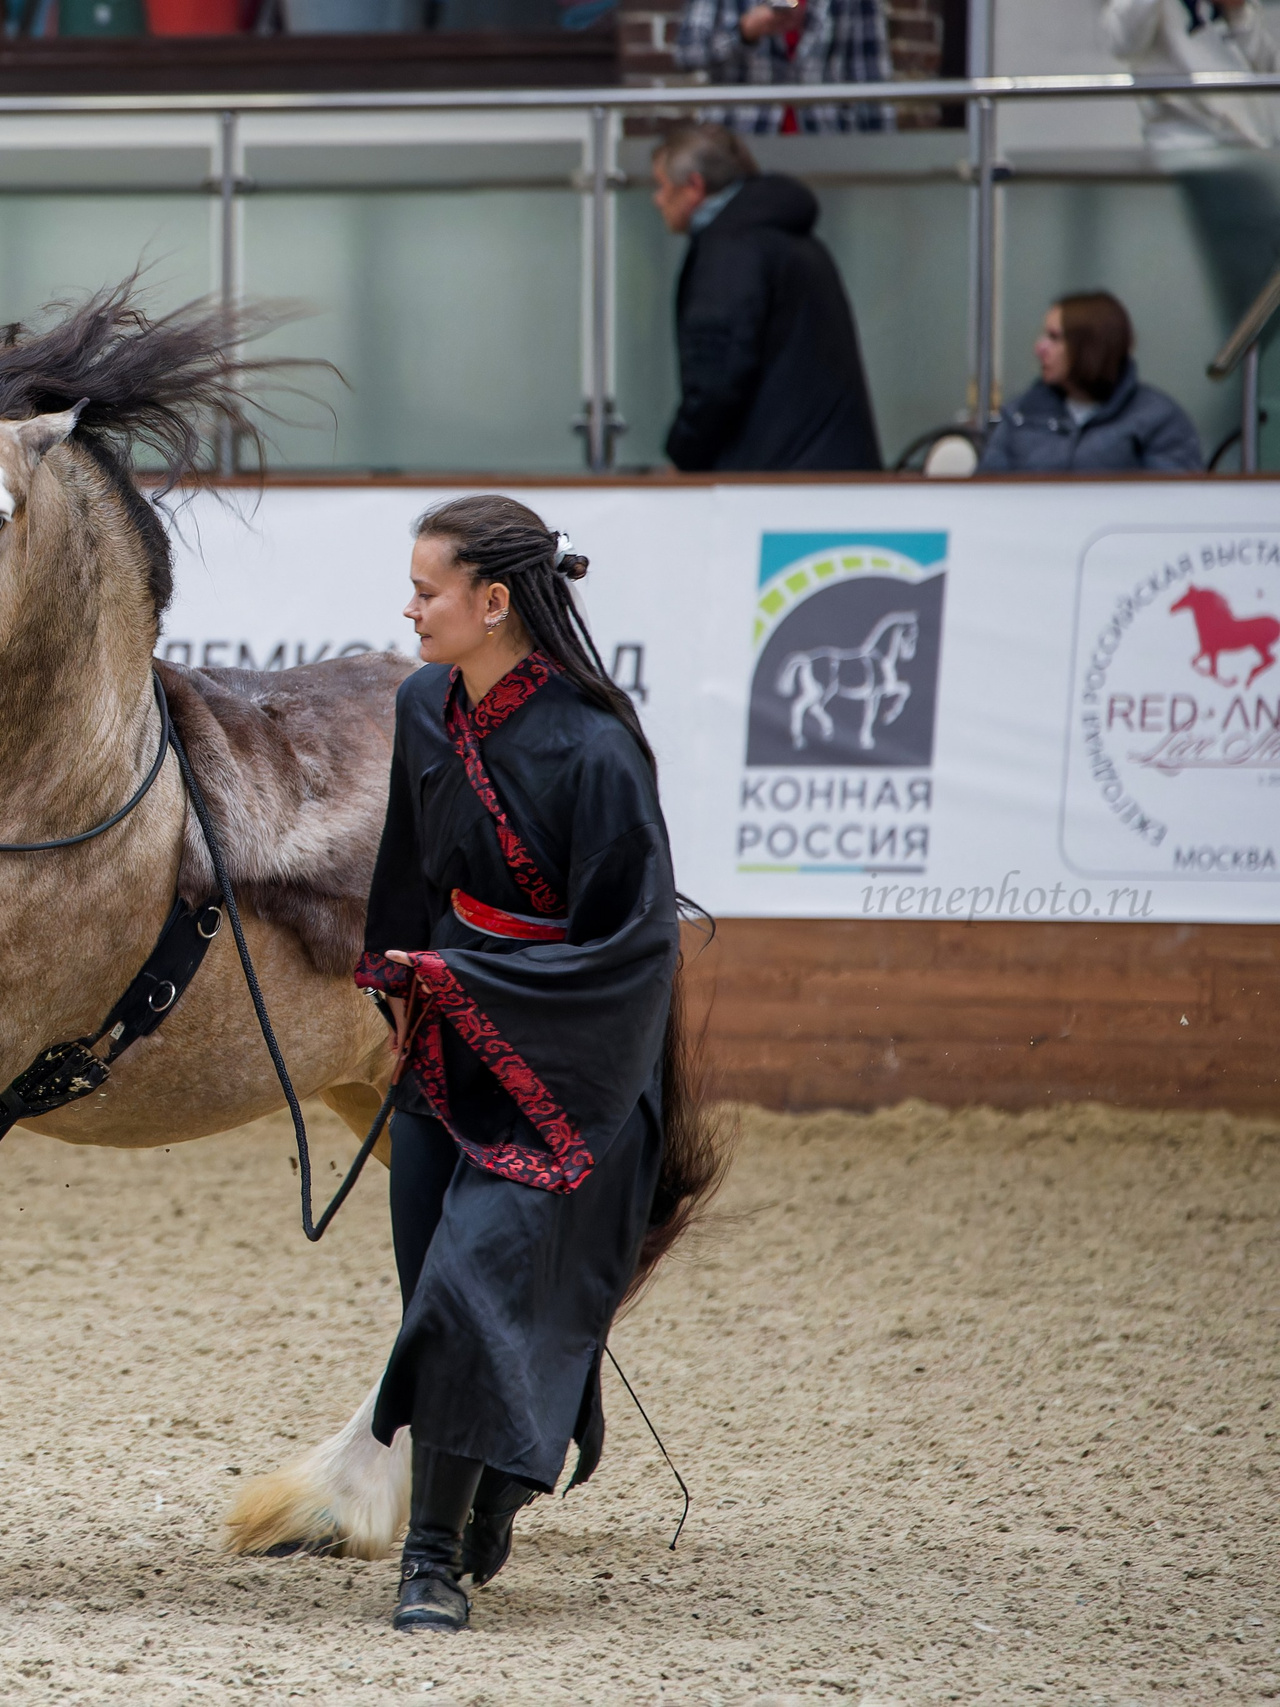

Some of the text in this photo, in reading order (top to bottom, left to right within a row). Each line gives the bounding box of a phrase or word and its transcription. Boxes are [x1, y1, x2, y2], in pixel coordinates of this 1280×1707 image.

[1083, 554, 1194, 704] РОССИЙСКАЯ
[740, 776, 933, 812] КОННАЯ
[736, 823, 929, 859] РОССИЯ
[1173, 845, 1276, 872] МОСКВА
